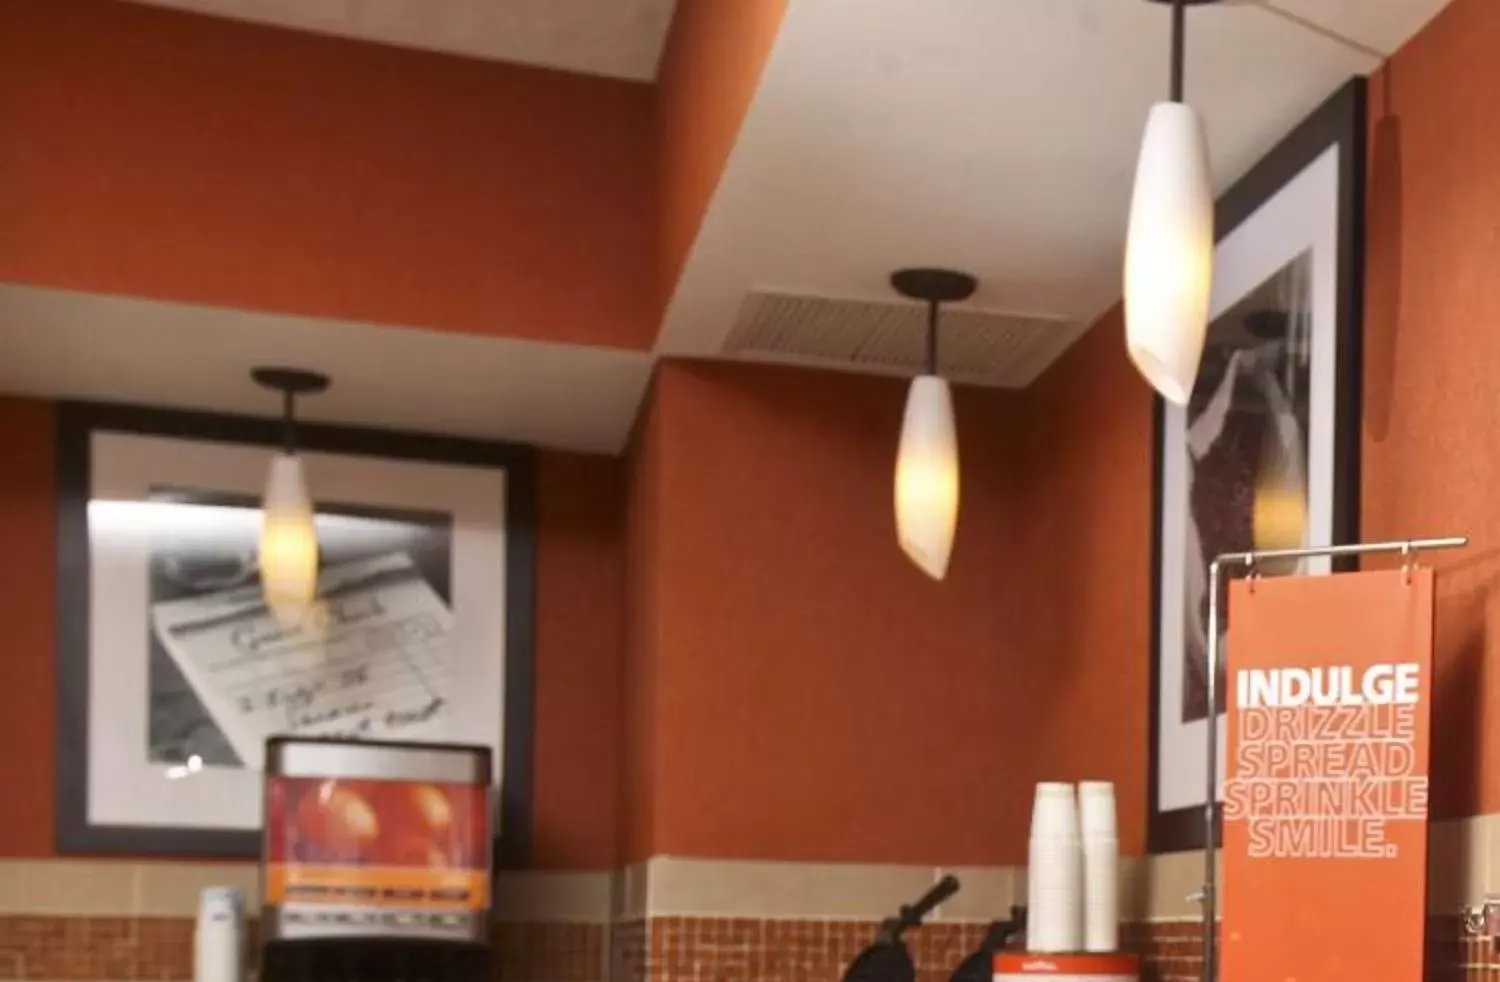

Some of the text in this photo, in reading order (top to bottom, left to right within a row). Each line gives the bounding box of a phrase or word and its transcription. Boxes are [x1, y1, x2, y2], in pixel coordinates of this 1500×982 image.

[1237, 663, 1420, 707] INDULGE
[1240, 704, 1415, 743] DRIZZLE
[1237, 740, 1415, 779] SPREAD
[1222, 776, 1429, 820] SPRINKLE
[1247, 817, 1398, 858] SMILE.
